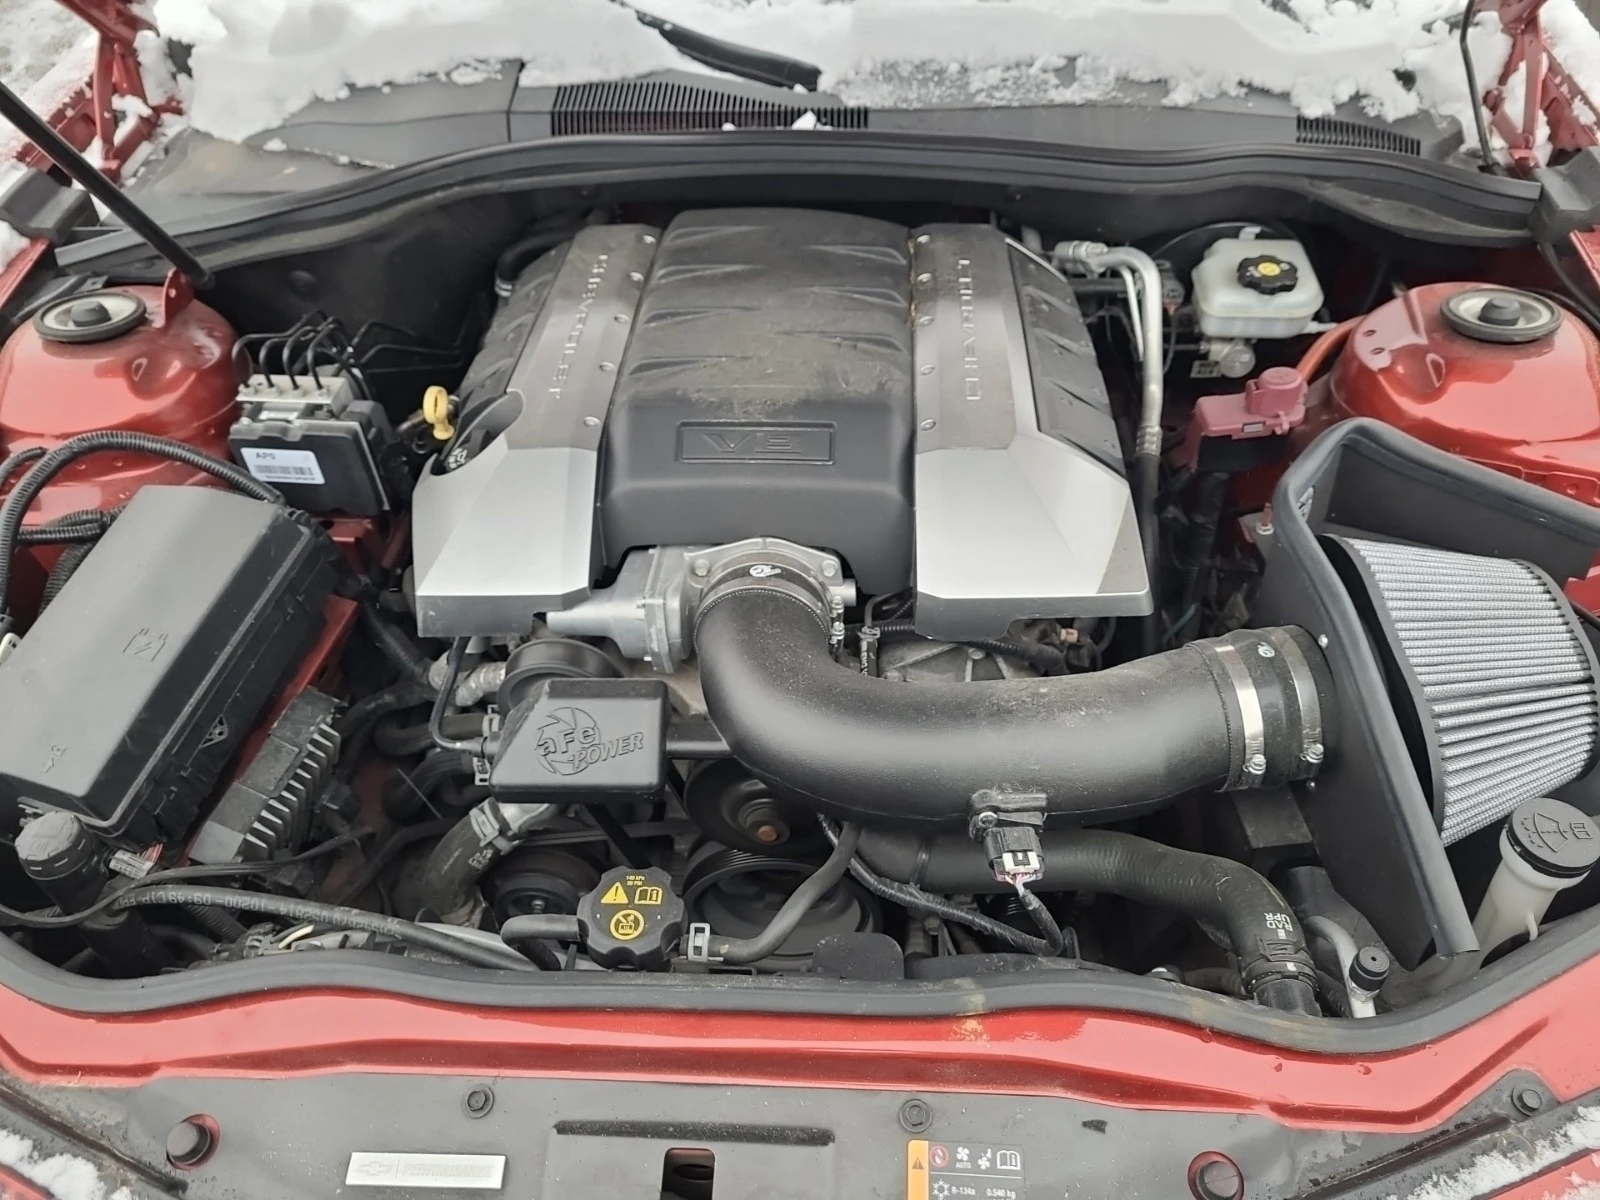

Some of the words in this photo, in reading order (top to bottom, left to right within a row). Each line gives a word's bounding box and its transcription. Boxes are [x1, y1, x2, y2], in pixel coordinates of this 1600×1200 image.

[957, 258, 982, 401] CHEVROLET
[537, 726, 597, 757] aFe
[570, 731, 644, 771] POWER
[955, 1161, 972, 1169] AUTO
[951, 1186, 976, 1196] R-134a
[1006, 1189, 1017, 1200] kg
